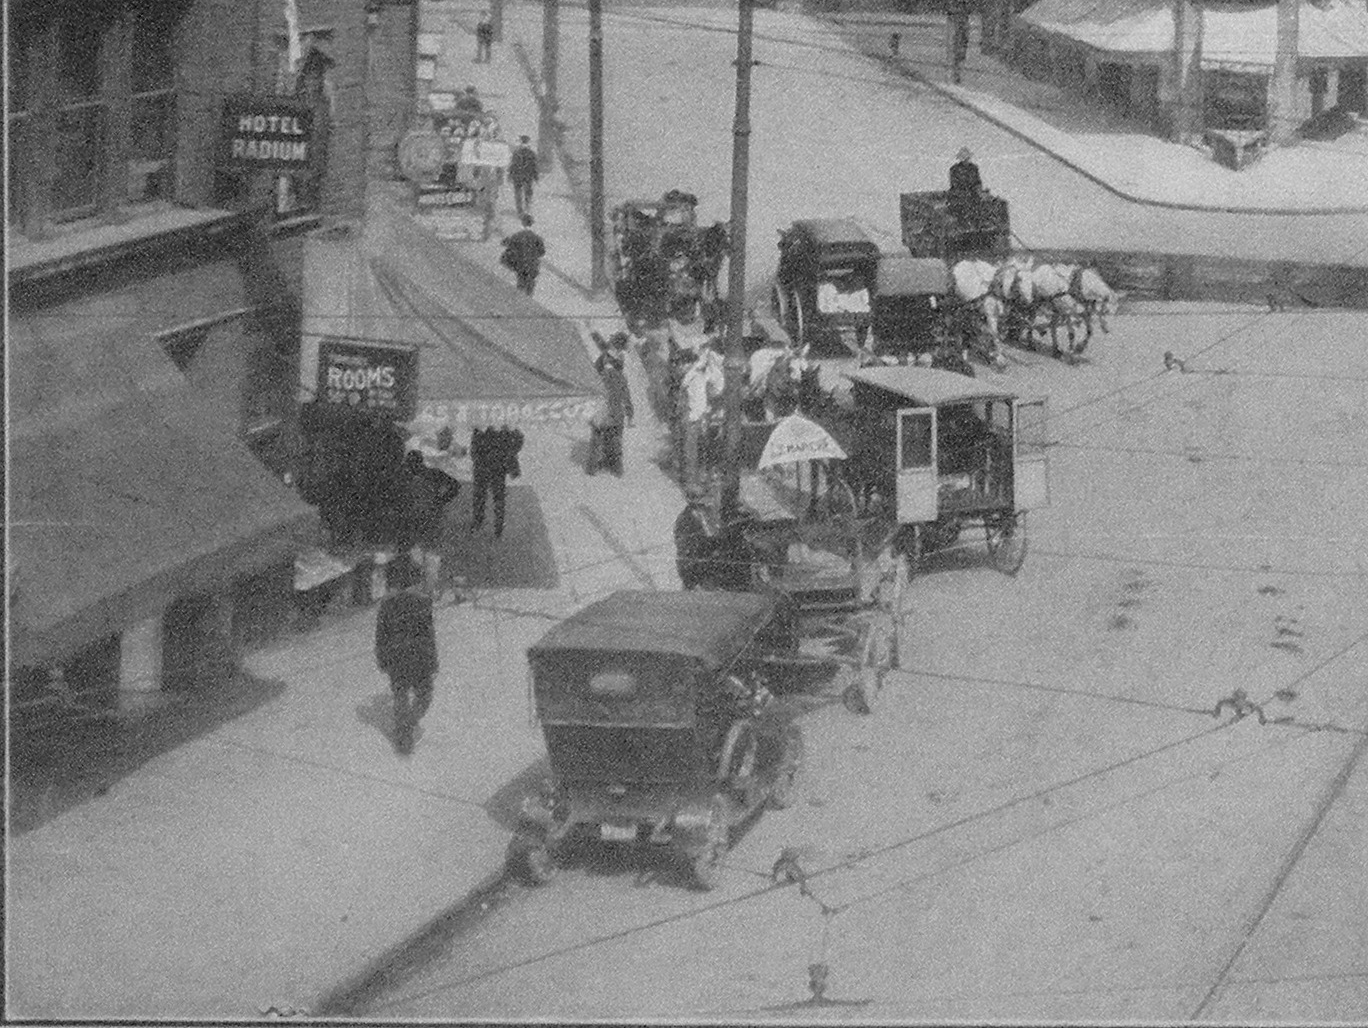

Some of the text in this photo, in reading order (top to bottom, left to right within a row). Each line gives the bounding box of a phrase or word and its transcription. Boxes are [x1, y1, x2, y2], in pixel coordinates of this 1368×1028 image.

[238, 114, 304, 134] HOTEL
[232, 138, 307, 160] RADIUM
[327, 365, 395, 390] ROOMS
